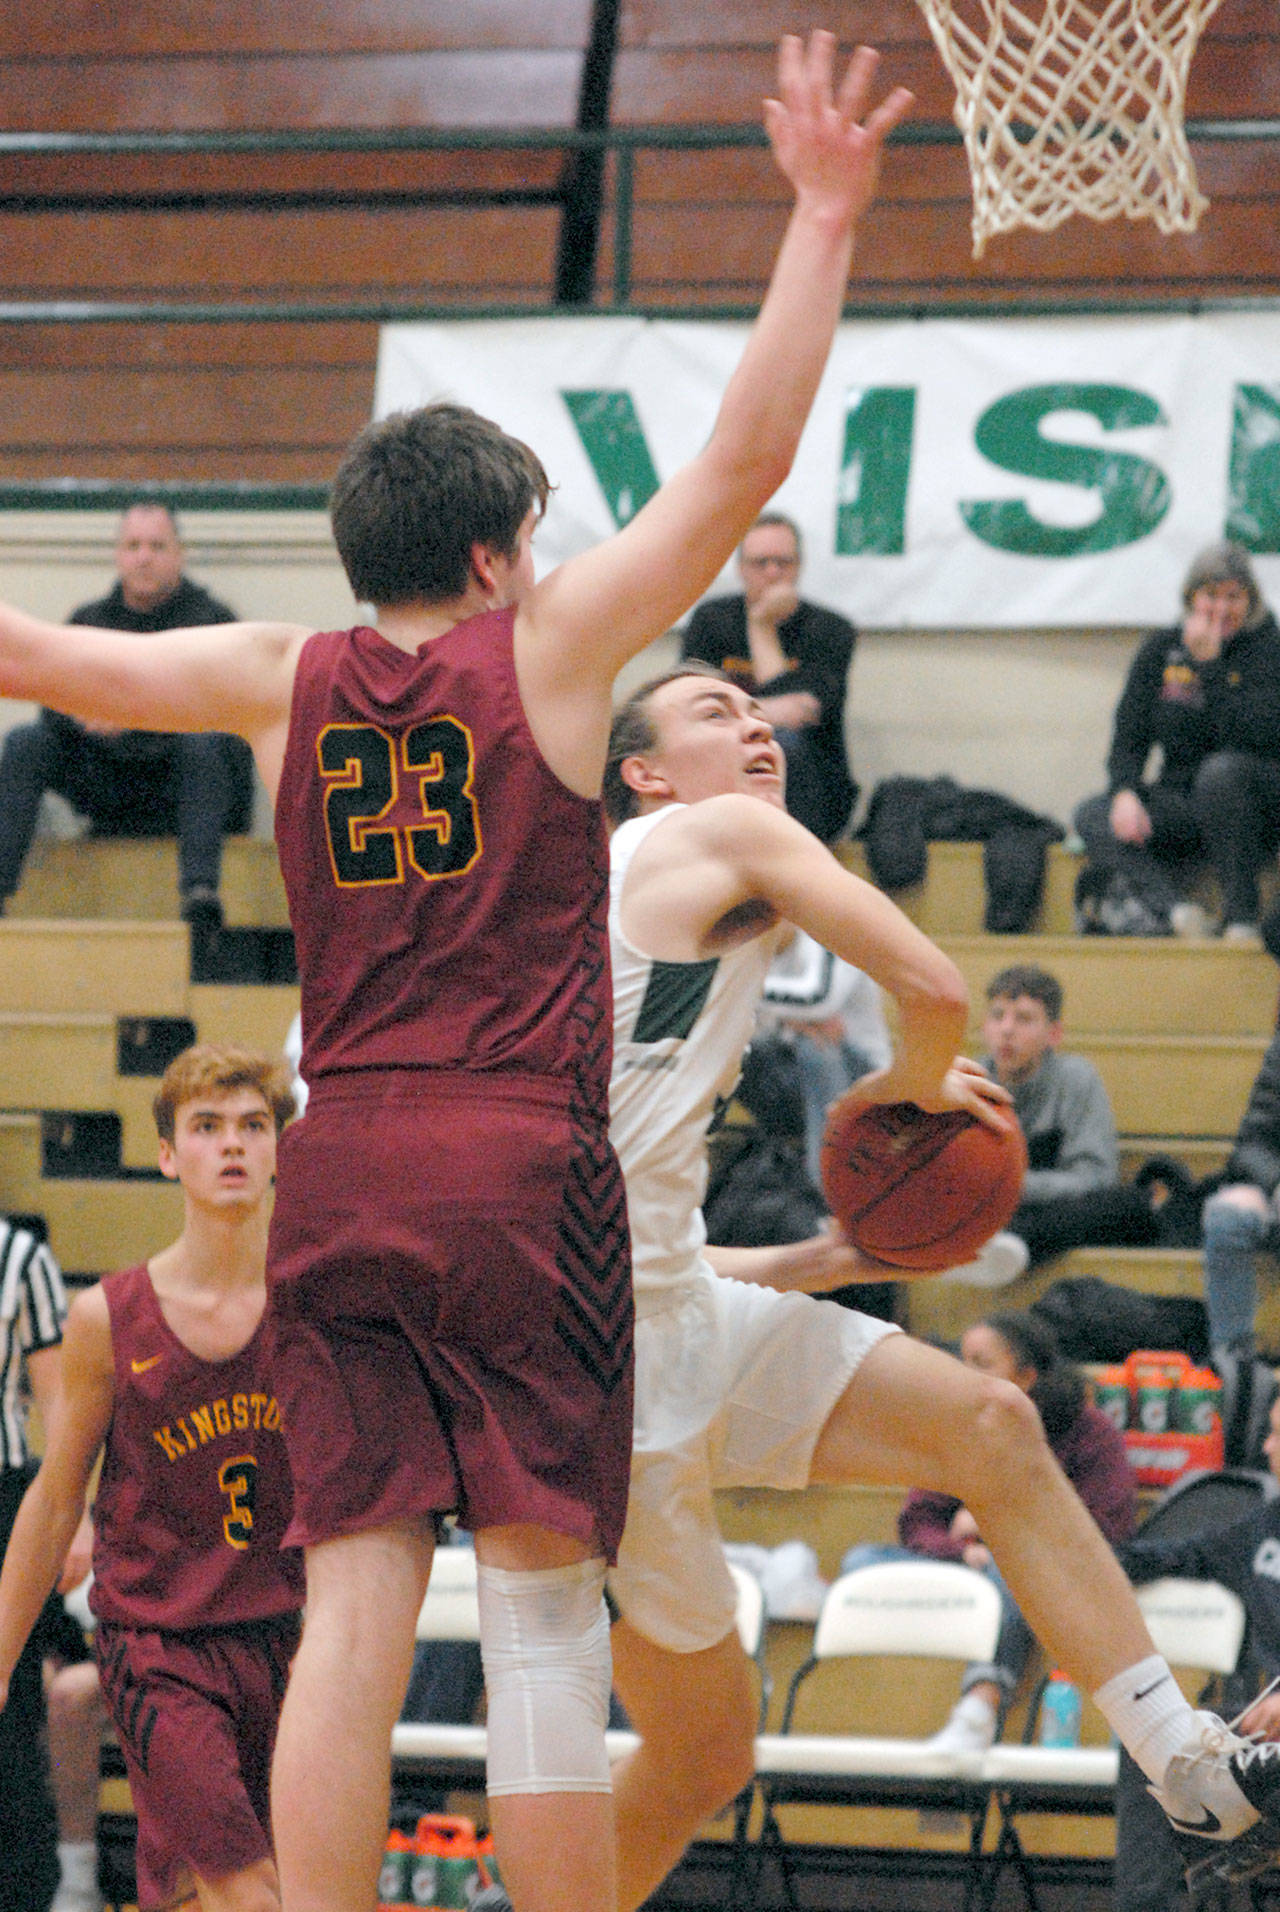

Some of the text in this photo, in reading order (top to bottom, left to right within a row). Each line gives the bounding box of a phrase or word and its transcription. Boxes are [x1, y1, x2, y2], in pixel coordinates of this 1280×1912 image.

[315, 714, 484, 888] 23
[152, 1393, 284, 1463] KINGSTO
[217, 1453, 258, 1550] 3
